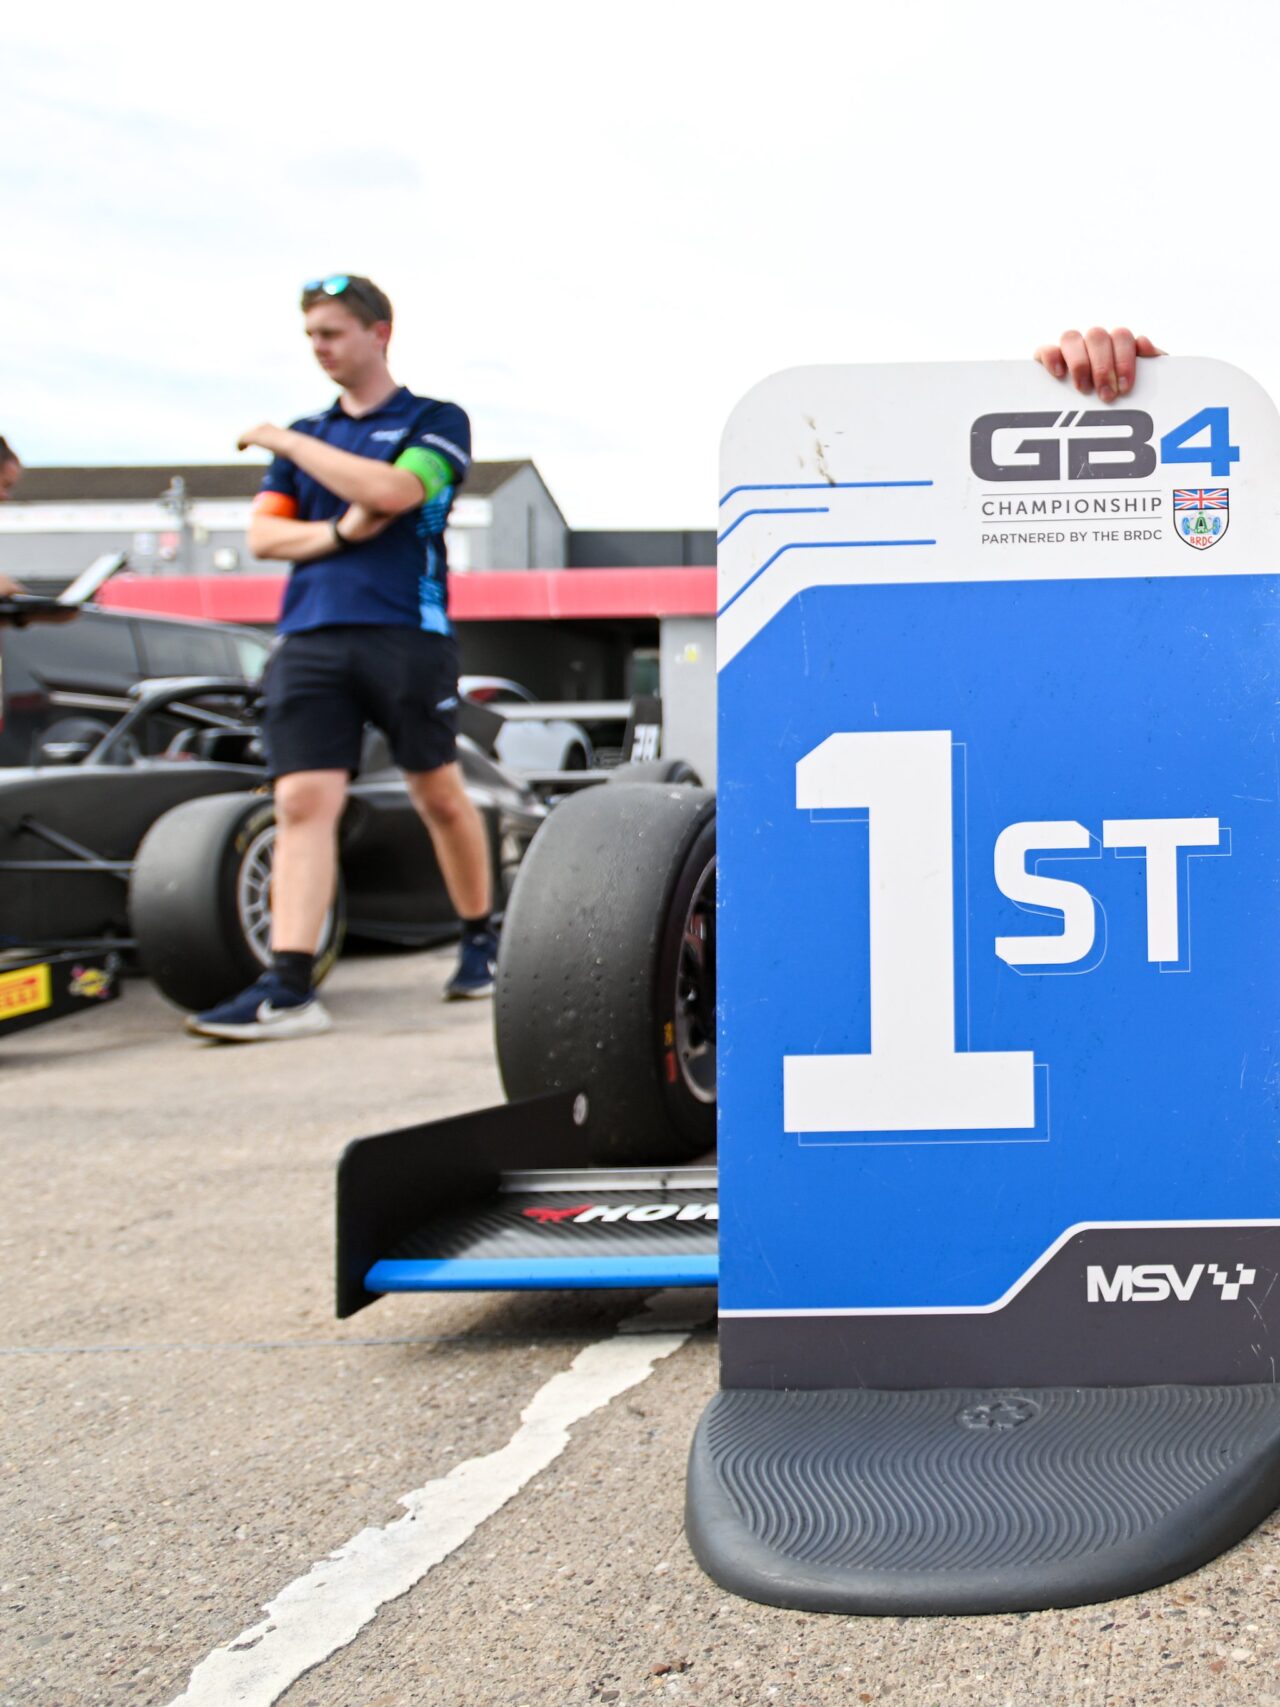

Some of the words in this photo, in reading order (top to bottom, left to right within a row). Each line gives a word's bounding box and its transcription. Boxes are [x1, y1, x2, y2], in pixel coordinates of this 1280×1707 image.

[970, 406, 1241, 482] GB4
[982, 496, 1163, 516] CHAMPIONSHIP
[981, 532, 1065, 545] PARTNERED
[1070, 531, 1088, 543] BY
[1093, 530, 1120, 543] THE
[1123, 529, 1163, 541] BRDC
[1189, 535, 1214, 547] BRDC
[783, 730, 1220, 1133] 1ST
[1086, 1263, 1206, 1303] MSV
